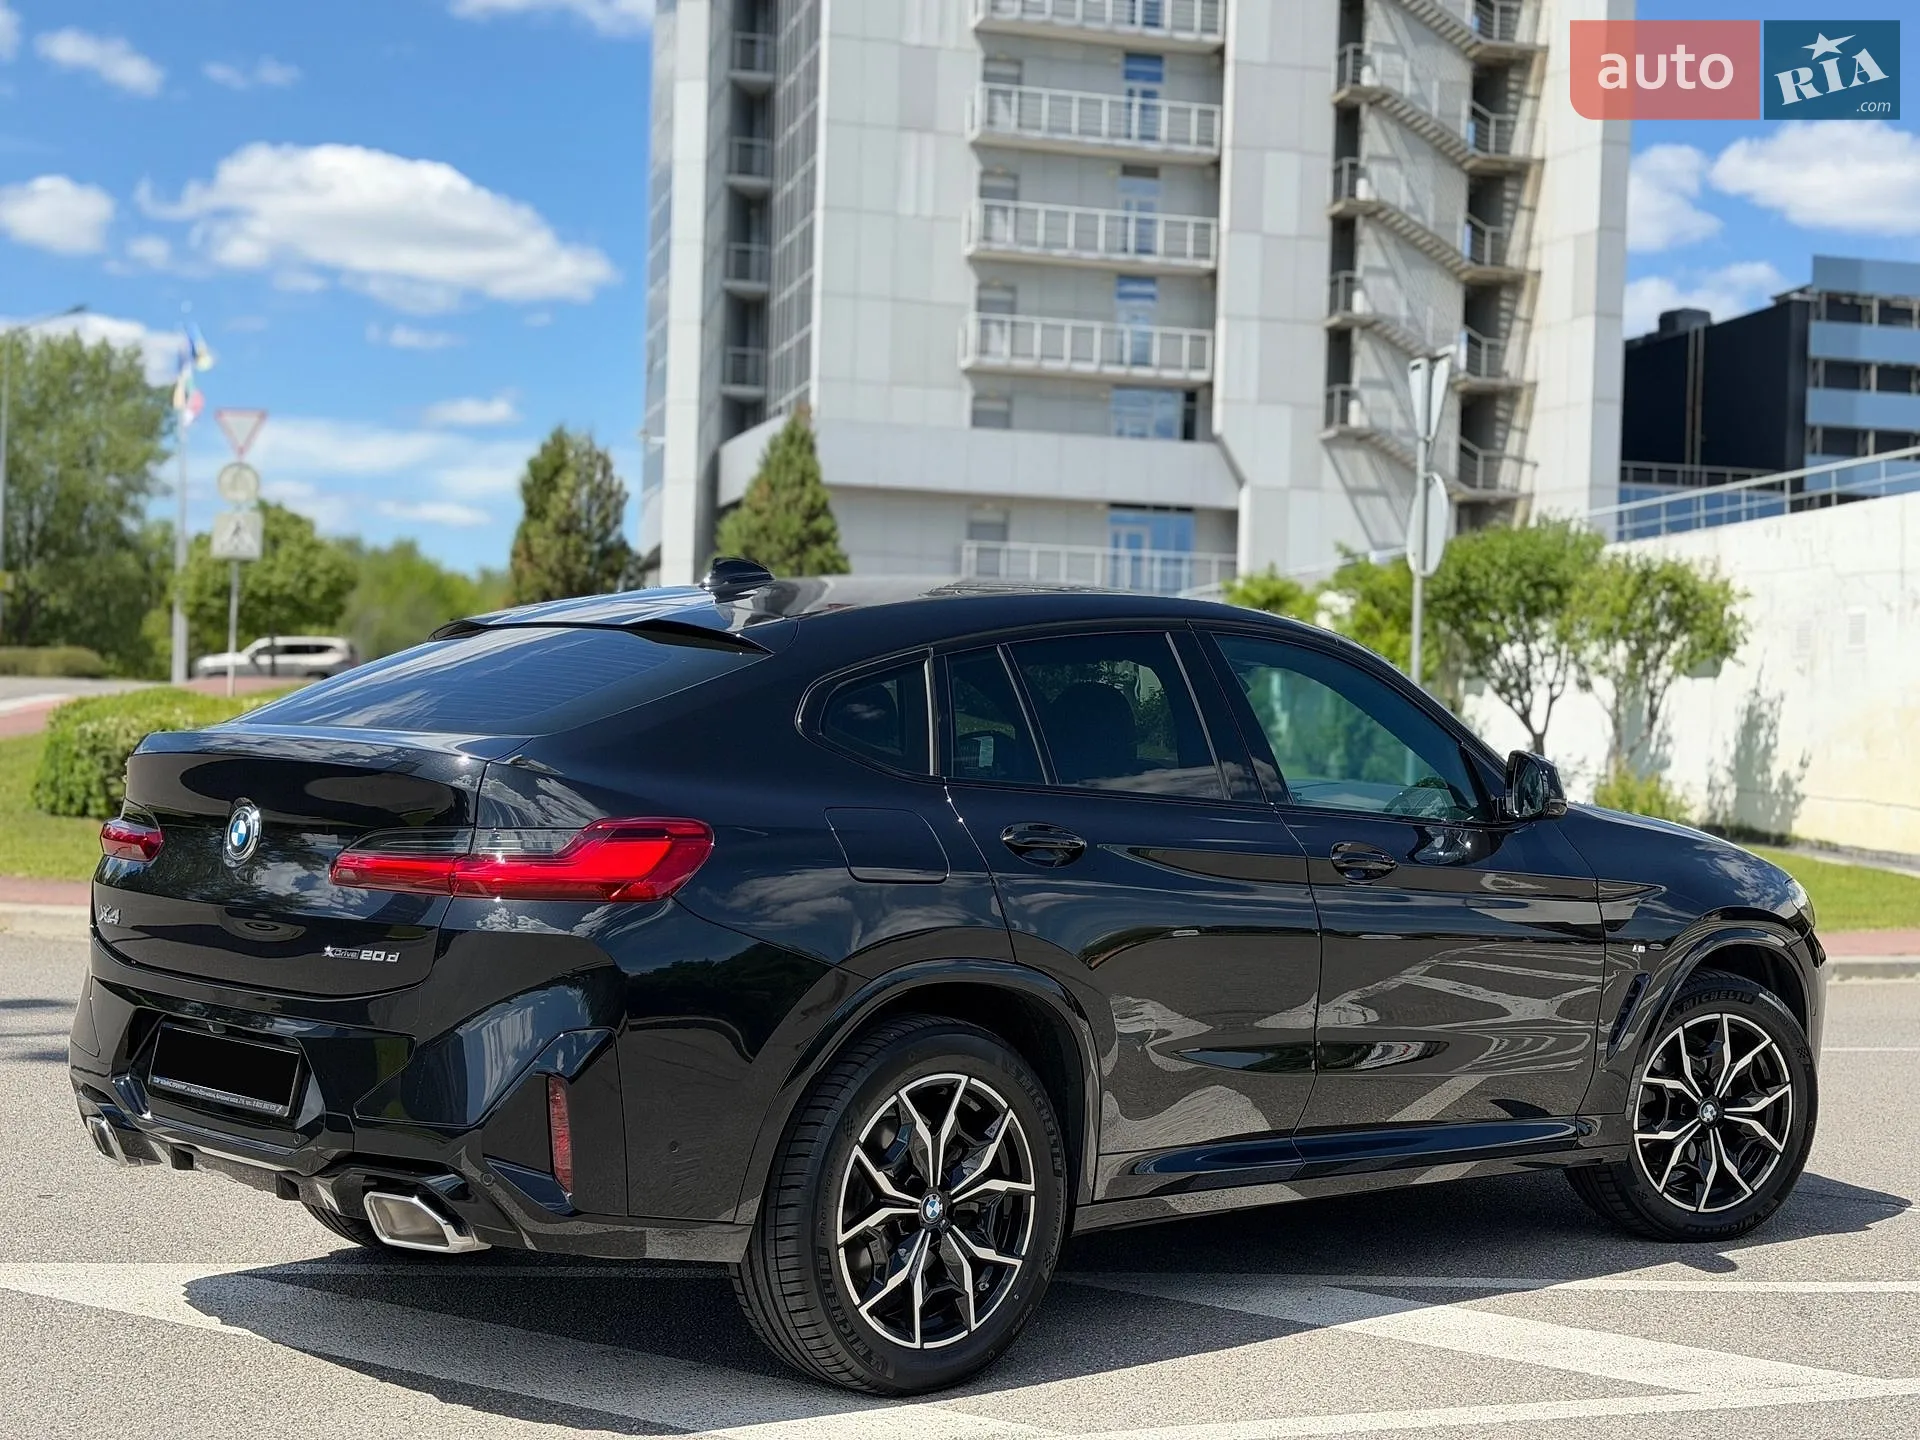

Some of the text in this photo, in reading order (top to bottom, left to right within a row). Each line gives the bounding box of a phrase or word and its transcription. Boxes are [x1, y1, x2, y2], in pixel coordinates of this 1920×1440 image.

[99, 904, 120, 925] X4
[1683, 990, 1753, 1012] MICHELIN
[818, 1254, 870, 1358] MICHELIN
